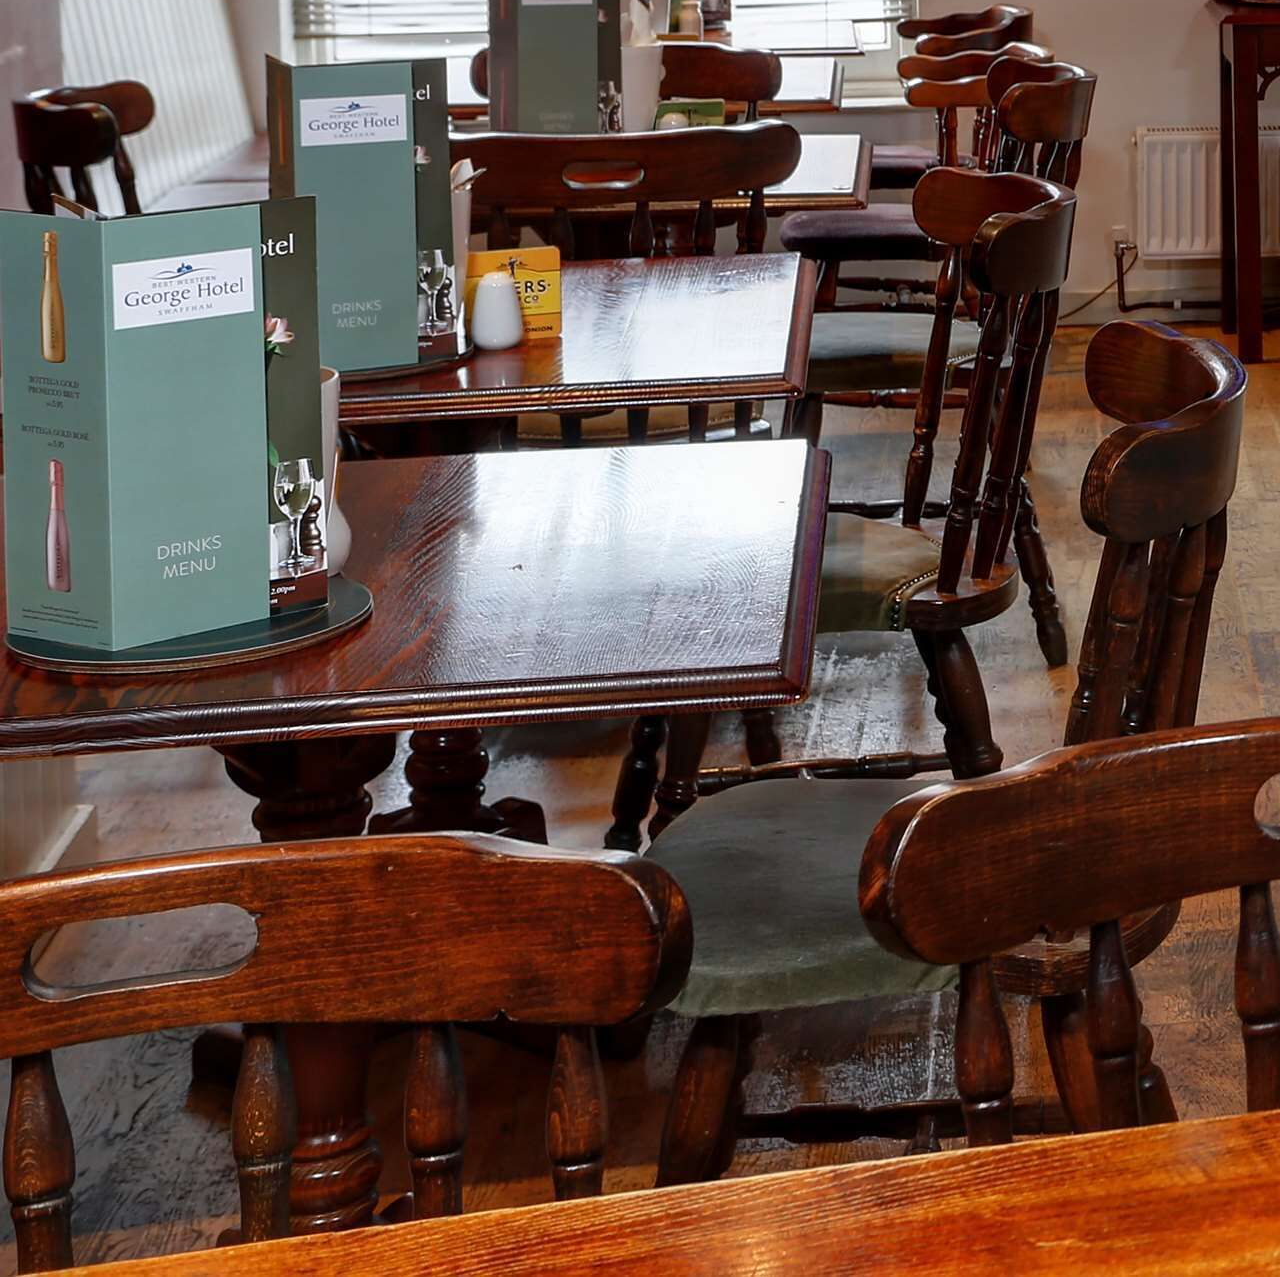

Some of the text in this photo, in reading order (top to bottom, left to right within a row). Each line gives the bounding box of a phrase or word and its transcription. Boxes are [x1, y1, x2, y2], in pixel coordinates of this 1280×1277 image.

[308, 115, 400, 133] George Hotel
[261, 233, 295, 257] otel
[152, 275, 217, 289] BEST WESTERN
[124, 277, 244, 308] George Hotel
[158, 303, 214, 316] SWAFFHAM
[331, 299, 382, 315] DRINKS
[336, 315, 377, 329] MENU
[157, 535, 222, 561] DRINKS
[163, 556, 216, 580] MENU
